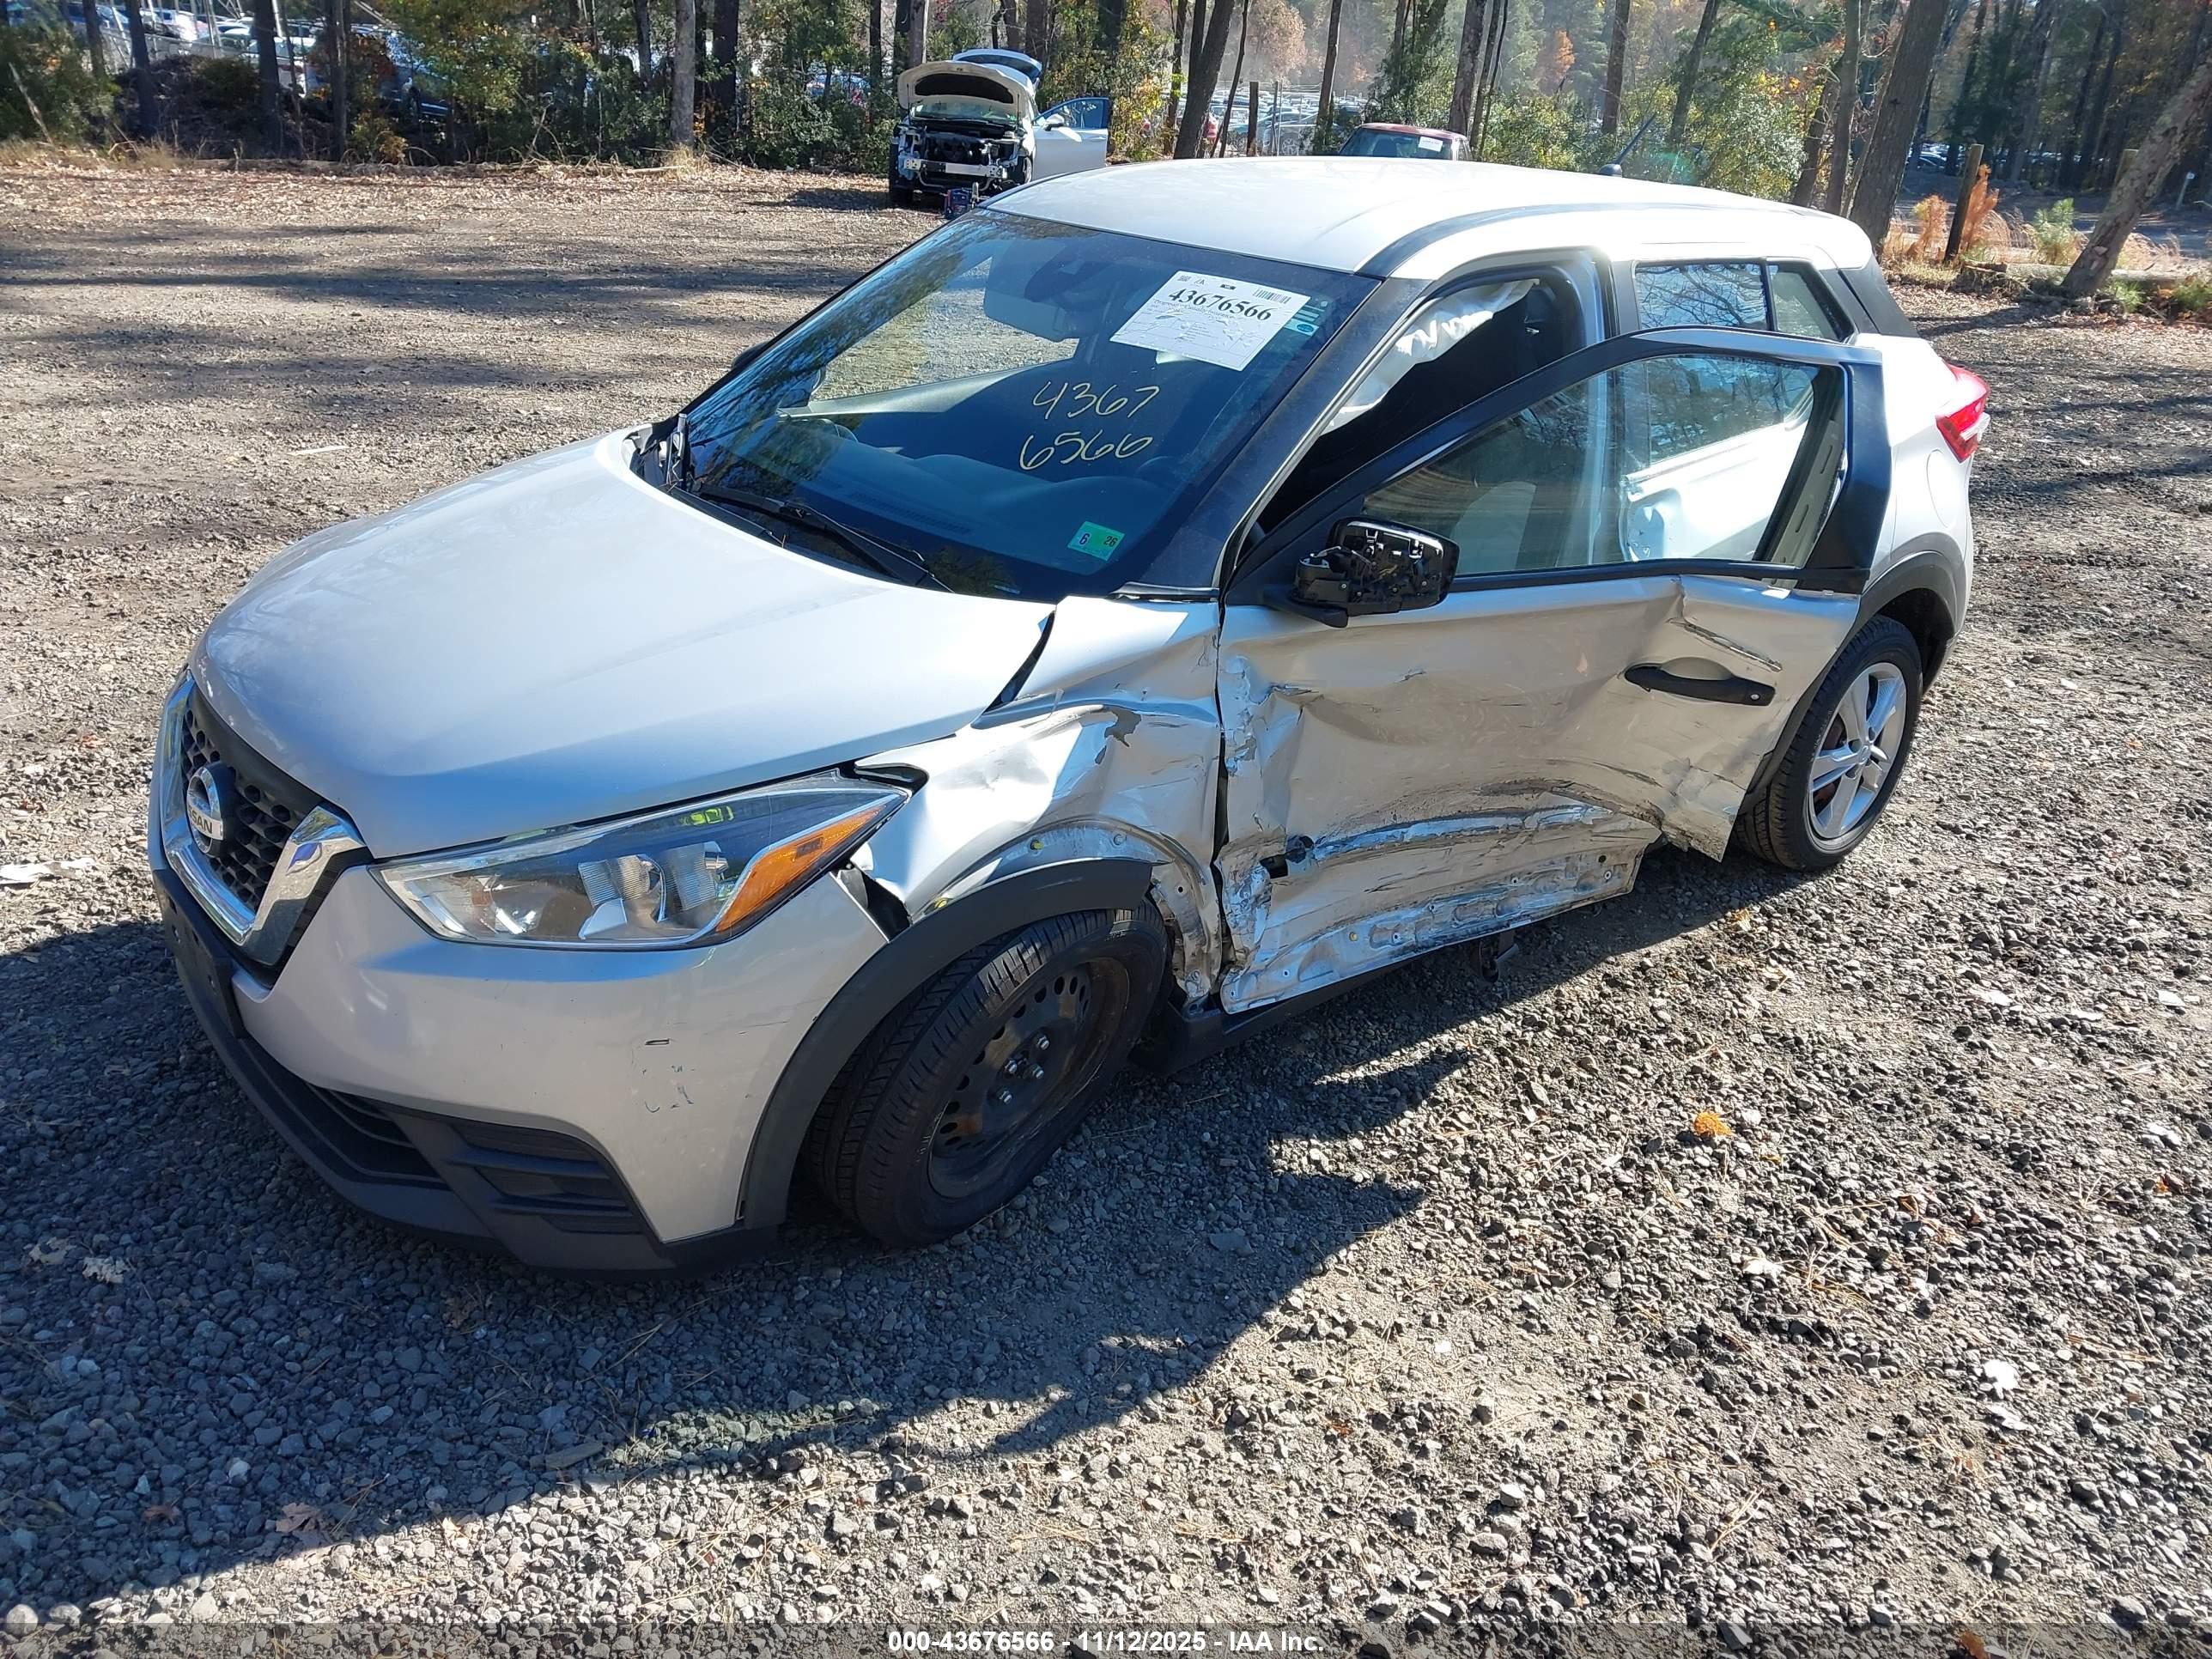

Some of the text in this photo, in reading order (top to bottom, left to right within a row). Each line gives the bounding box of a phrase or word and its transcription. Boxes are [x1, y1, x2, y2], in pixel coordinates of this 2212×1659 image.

[1168, 288, 1279, 322] 43676566
[1032, 380, 1160, 420] 4367
[1019, 429, 1154, 471] 6566
[1079, 532, 1118, 547] 6 26
